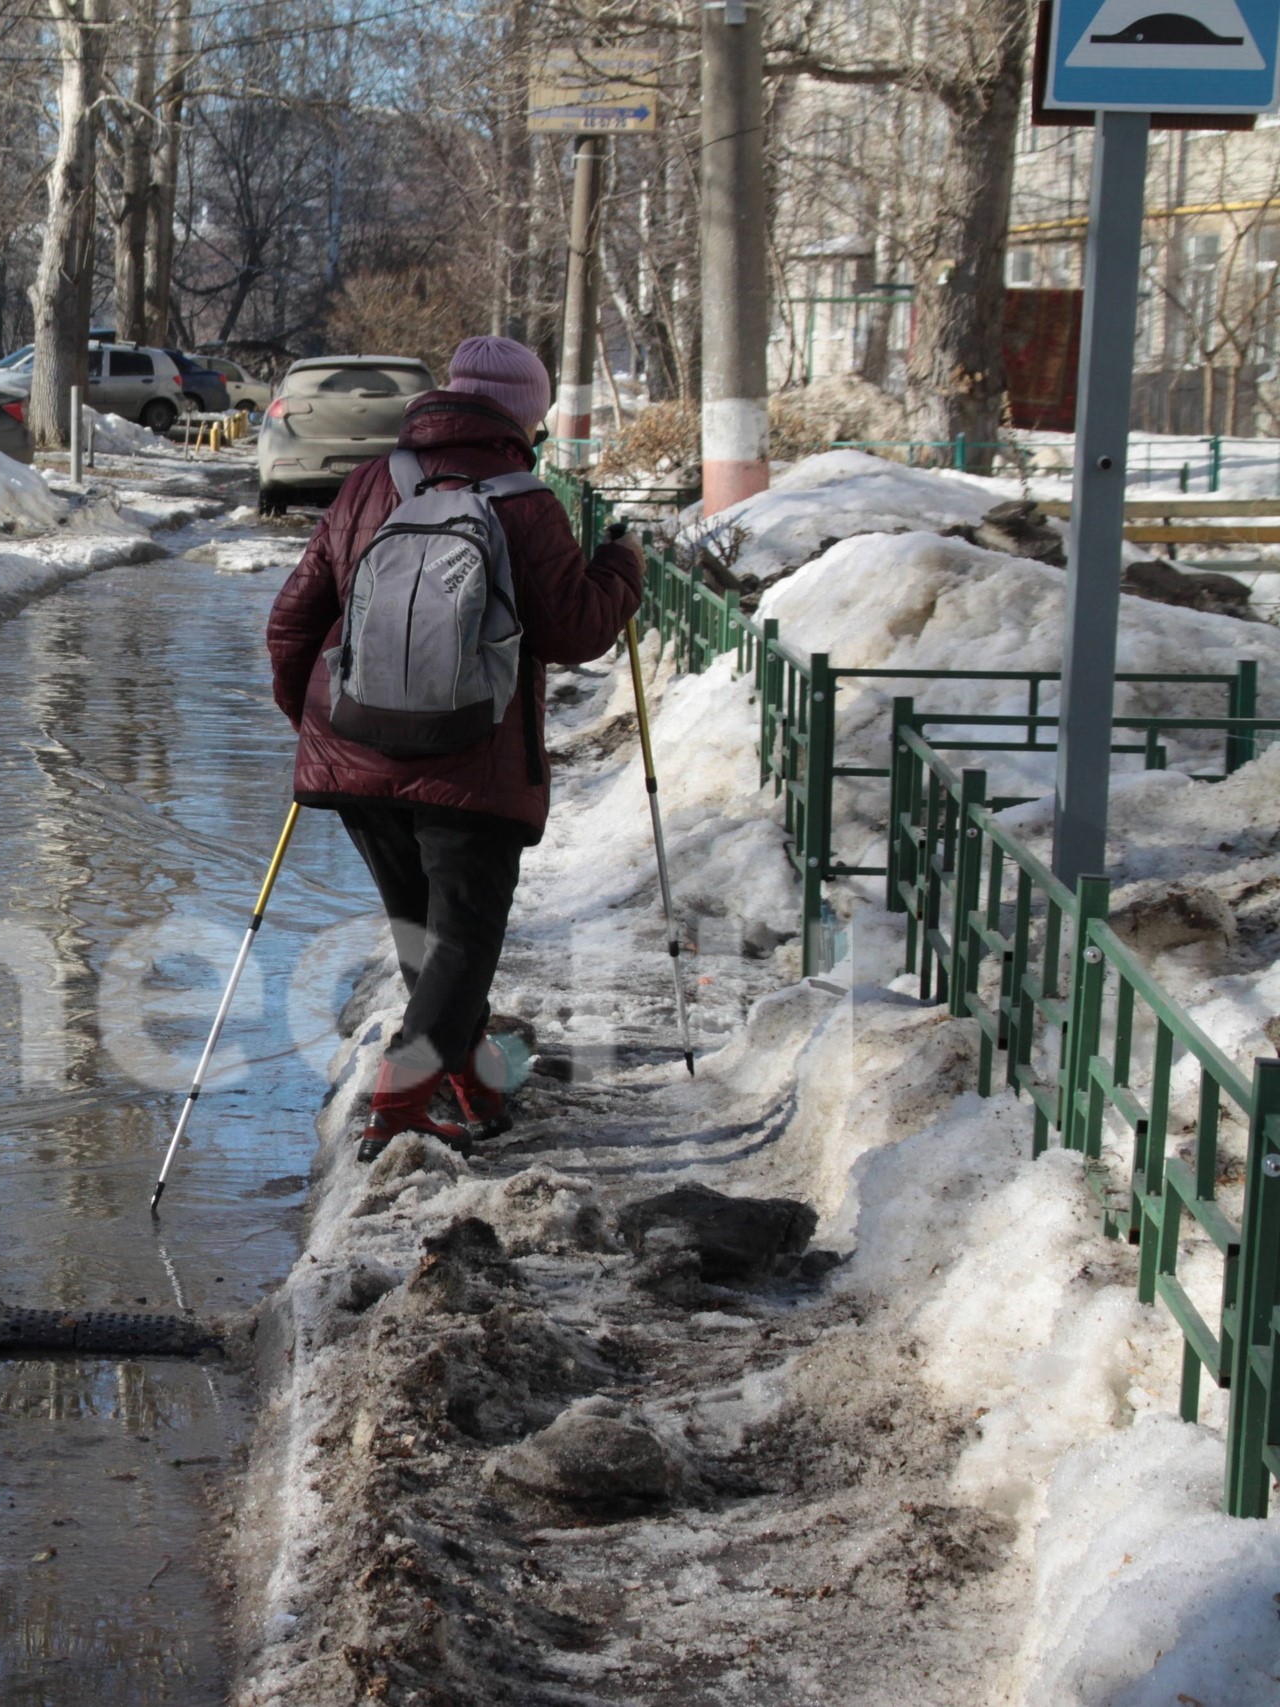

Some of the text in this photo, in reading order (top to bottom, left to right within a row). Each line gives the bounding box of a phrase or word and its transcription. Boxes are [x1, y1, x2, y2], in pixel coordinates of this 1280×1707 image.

[423, 541, 468, 573] NETWORK
[447, 547, 471, 567] from
[444, 553, 480, 594] world
[444, 573, 458, 586] the
